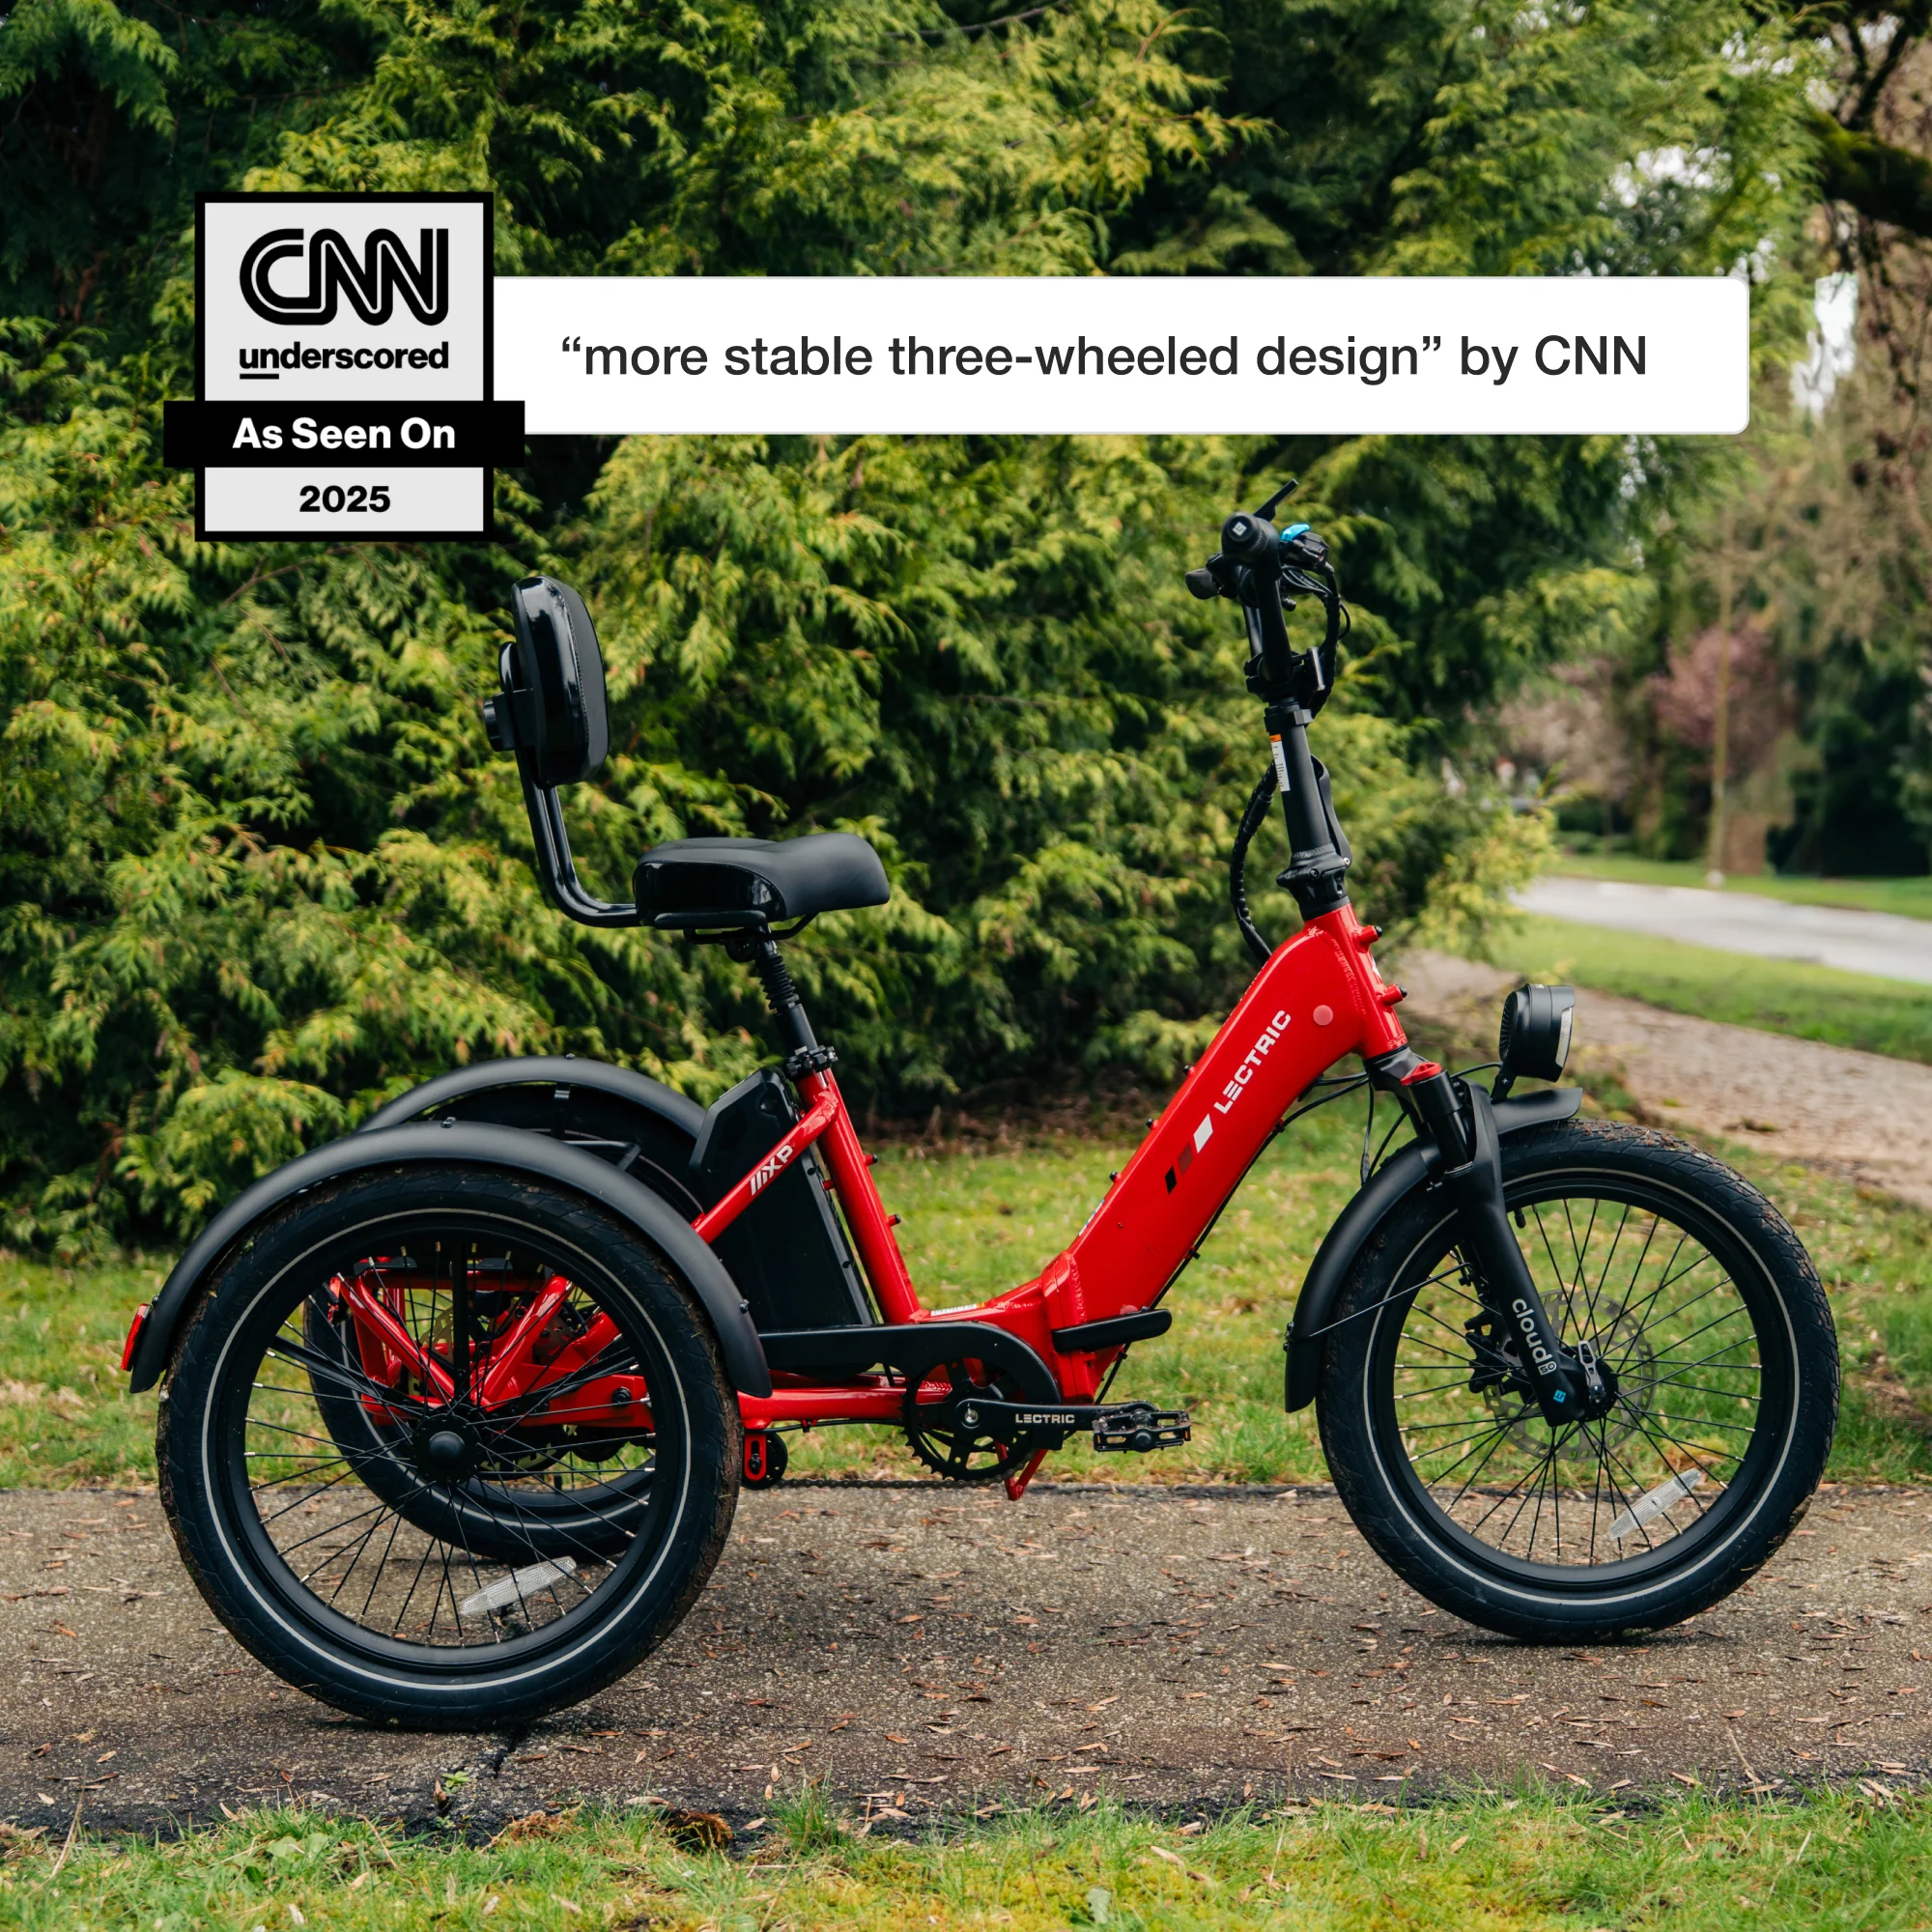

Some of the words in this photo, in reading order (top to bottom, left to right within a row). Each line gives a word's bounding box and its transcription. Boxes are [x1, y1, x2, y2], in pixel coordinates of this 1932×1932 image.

[1213, 1009, 1292, 1115] LECTRIC
[1512, 1298, 1552, 1364] cloud
[1014, 1413, 1075, 1425] LECTRIC
